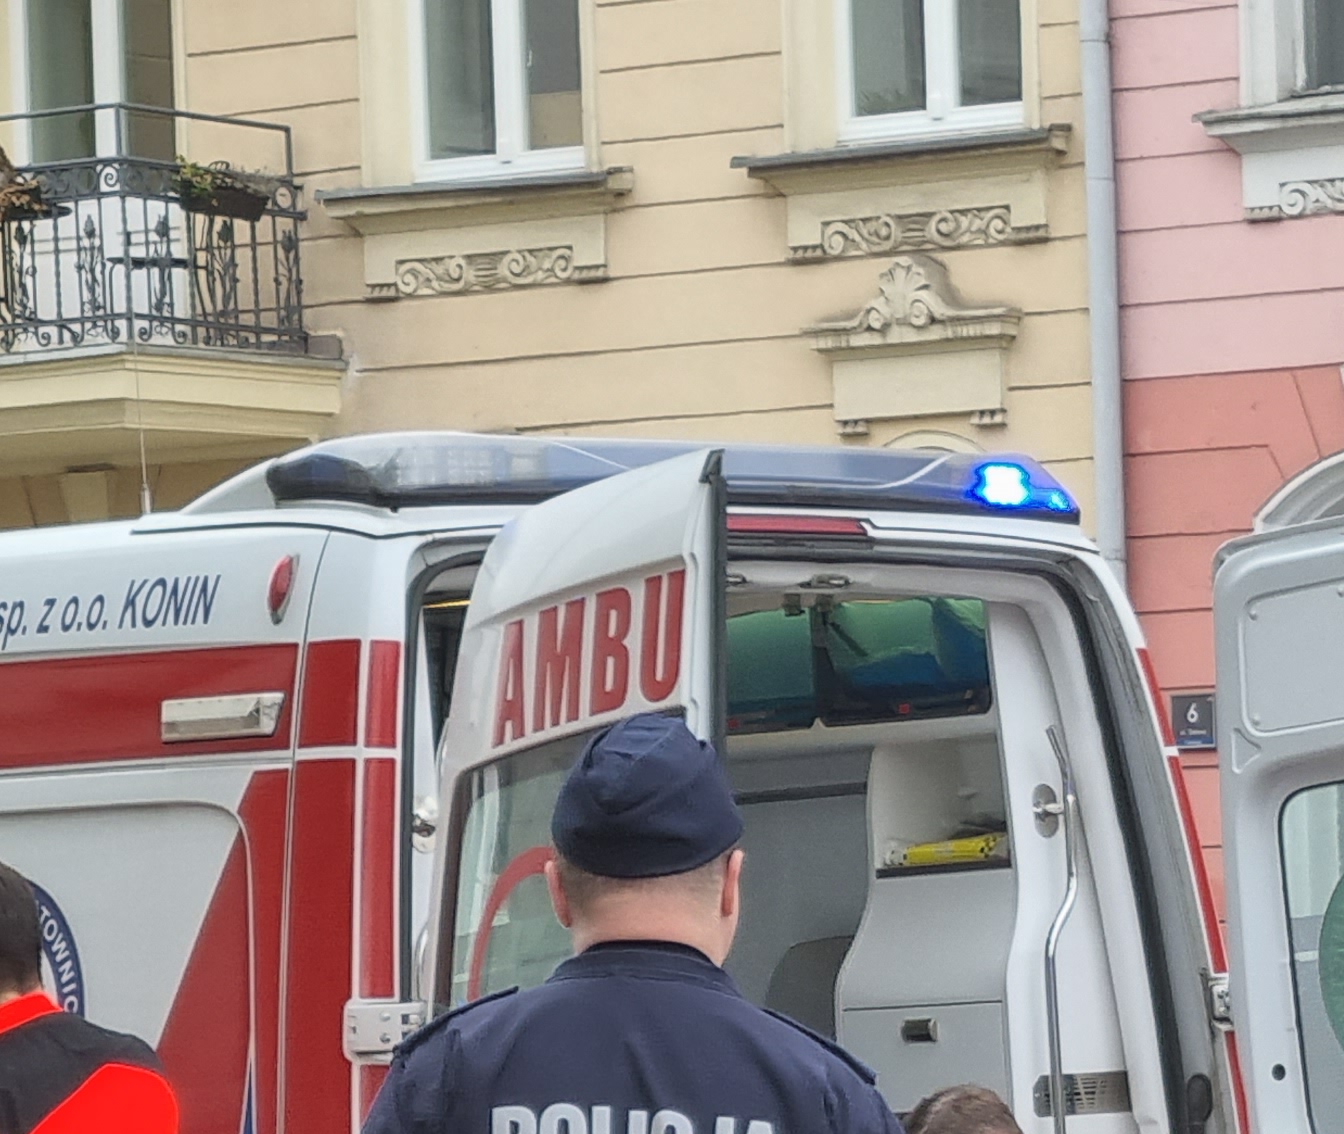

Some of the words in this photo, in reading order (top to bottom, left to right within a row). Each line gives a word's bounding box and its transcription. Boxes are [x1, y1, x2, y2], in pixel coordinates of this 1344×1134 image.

[35, 597, 57, 634] z
[60, 594, 107, 632] o.o.
[117, 574, 222, 629] KONIN
[491, 568, 686, 748] AMBU
[1187, 702, 1199, 724] 6
